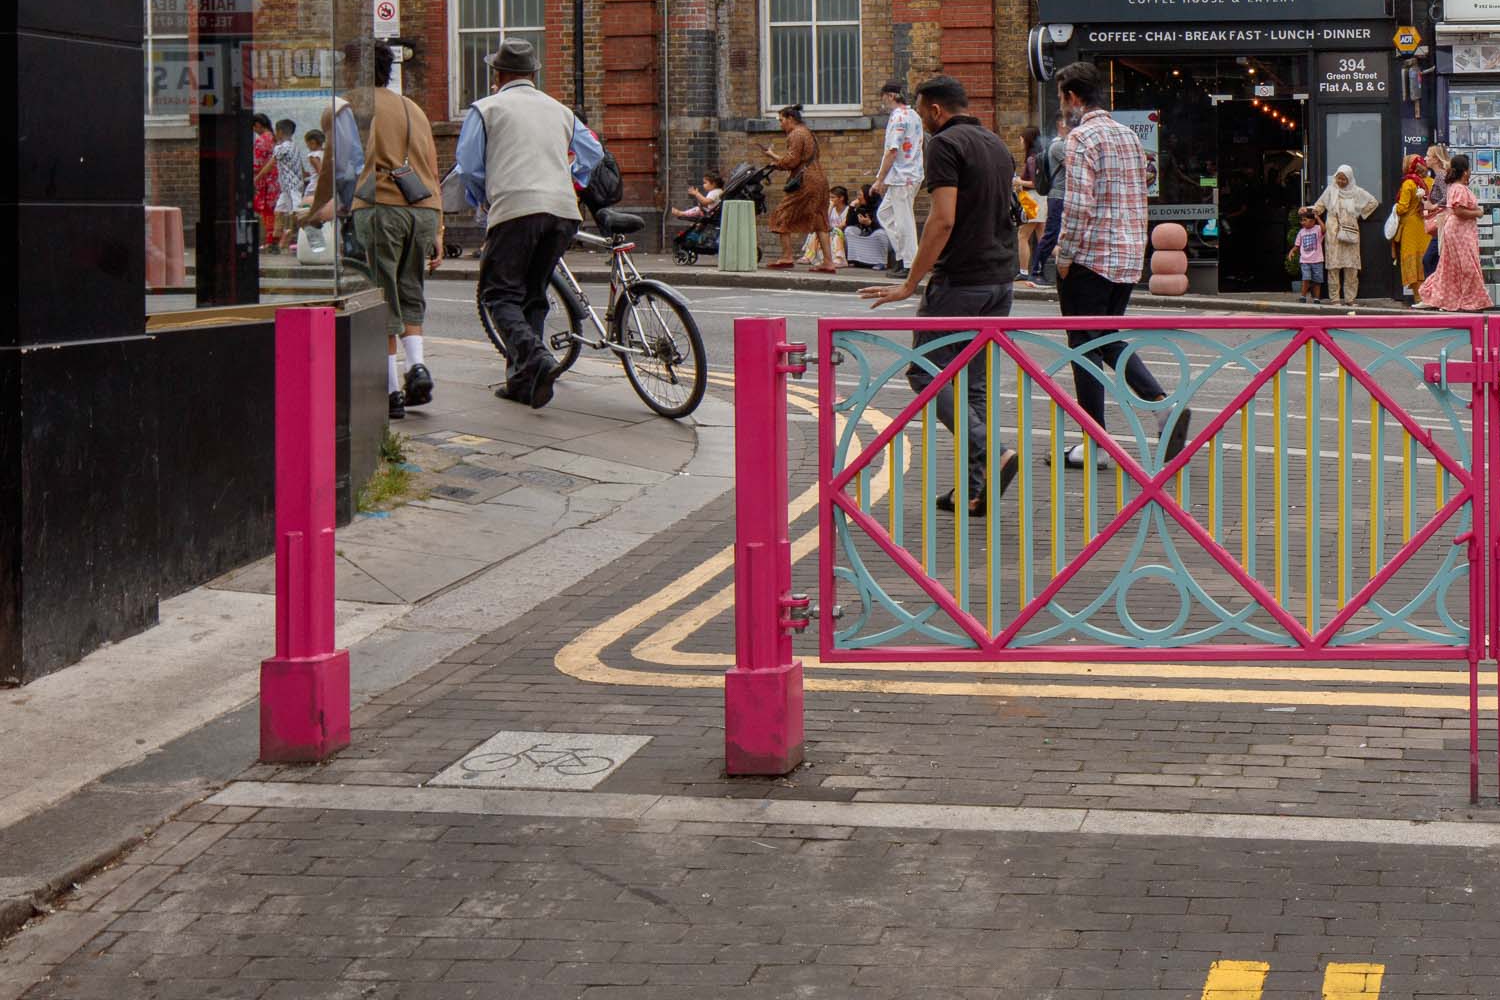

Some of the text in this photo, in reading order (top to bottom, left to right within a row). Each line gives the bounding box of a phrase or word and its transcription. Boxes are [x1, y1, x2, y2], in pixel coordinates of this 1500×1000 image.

[1089, 30, 1137, 43] COFFEE
[1145, 30, 1176, 42] CHAI
[1270, 29, 1315, 40] LUNCH
[1323, 28, 1371, 39] DINNER
[1339, 58, 1365, 72] 394
[1326, 71, 1377, 80] Green Street
[1319, 81, 1385, 94] Flat A, B & C
[1160, 208, 1216, 216] DOWNSTAIRS
